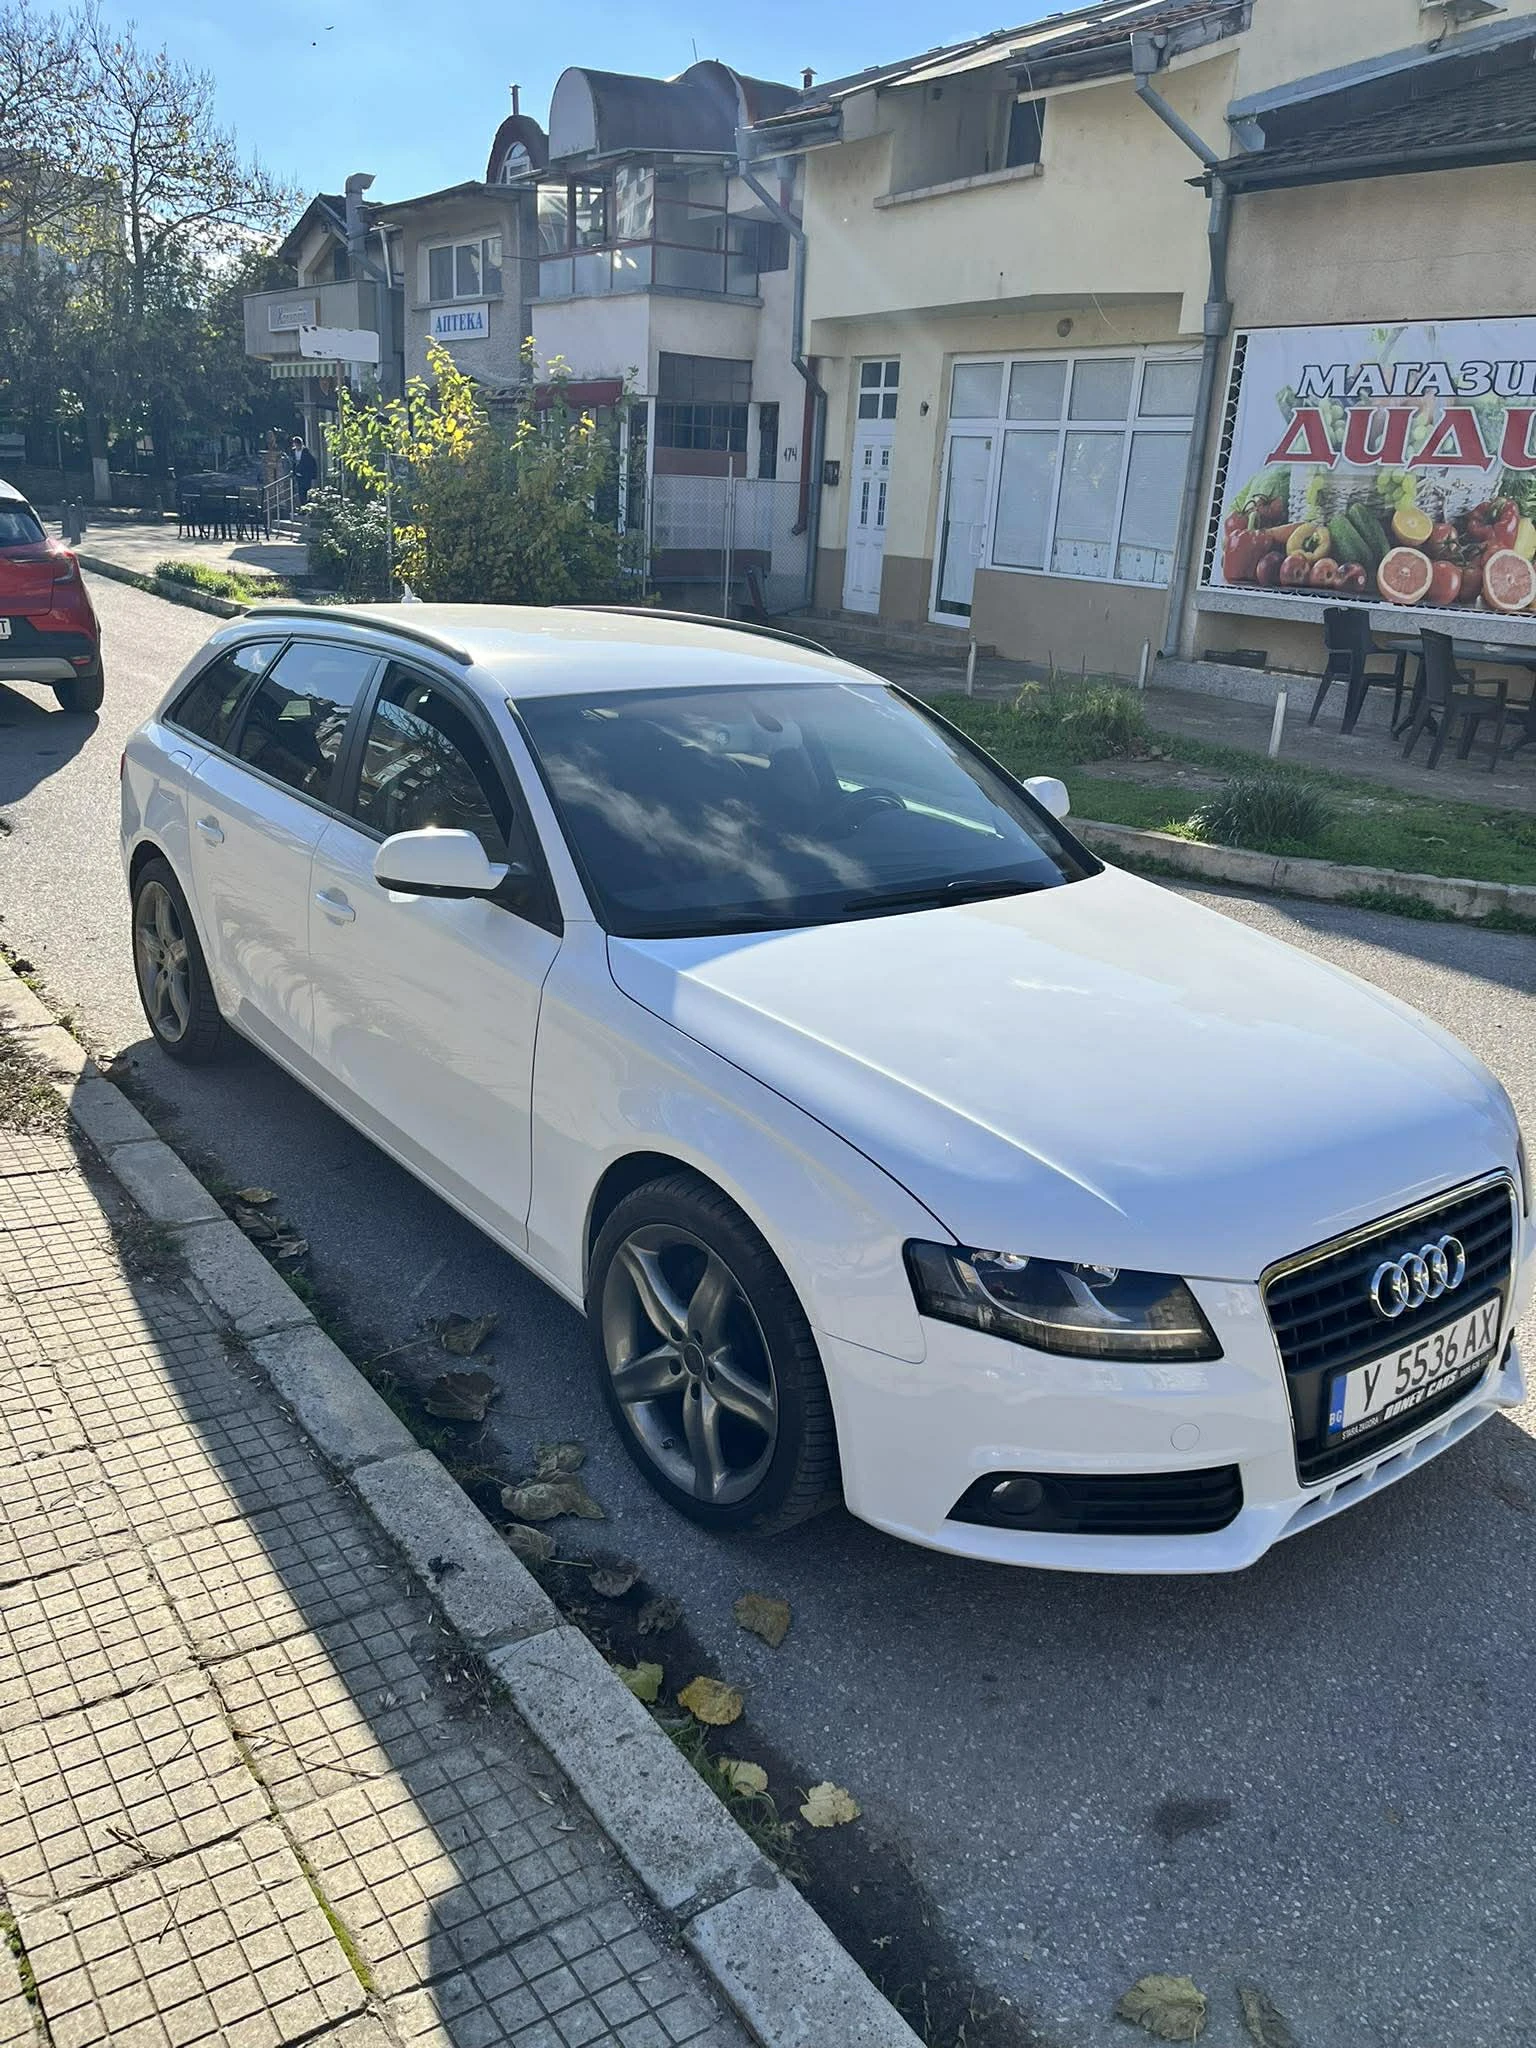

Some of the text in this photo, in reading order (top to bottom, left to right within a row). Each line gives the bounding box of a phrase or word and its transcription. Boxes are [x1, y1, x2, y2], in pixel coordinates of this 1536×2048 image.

[435, 312, 483, 333] АПТЕКА
[1394, 1324, 1458, 1395] 5536
[1463, 1303, 1495, 1359] AX
[1426, 1369, 1459, 1398] CARS
[1328, 1409, 1344, 1427] BG
